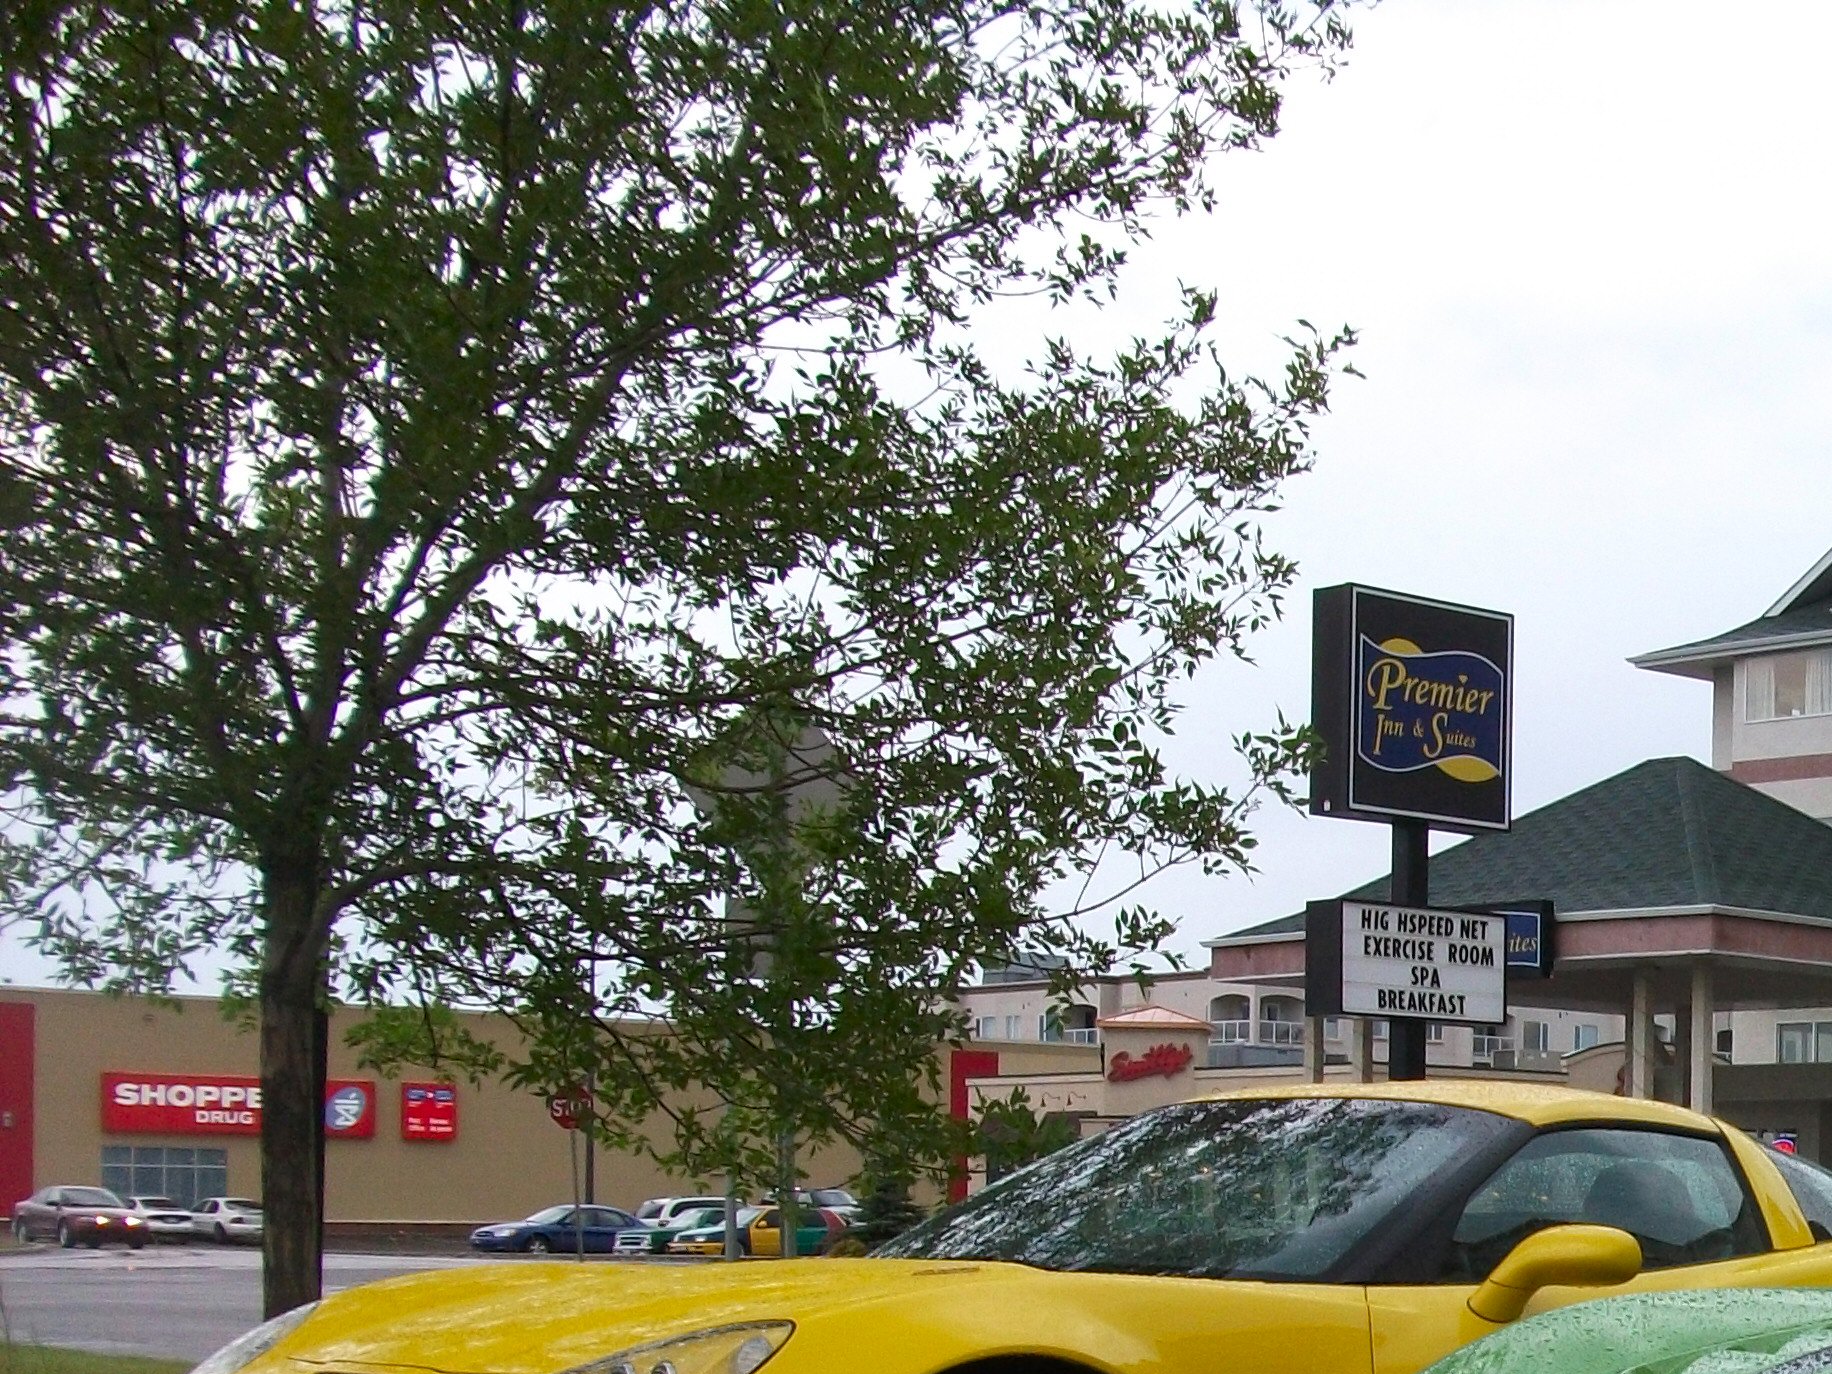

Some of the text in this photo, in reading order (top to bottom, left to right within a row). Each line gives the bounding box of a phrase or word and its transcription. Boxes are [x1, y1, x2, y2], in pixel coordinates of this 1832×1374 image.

[1367, 658, 1494, 715] Premier
[1372, 712, 1476, 758] Inn & Suites
[1361, 908, 1488, 940] HIG HSPEED NET
[1364, 935, 1494, 966] EXERCISE ROOM
[1411, 966, 1441, 988] SPA
[1378, 989, 1466, 1015] BREAKFAST
[196, 1110, 253, 1125] DRUG
